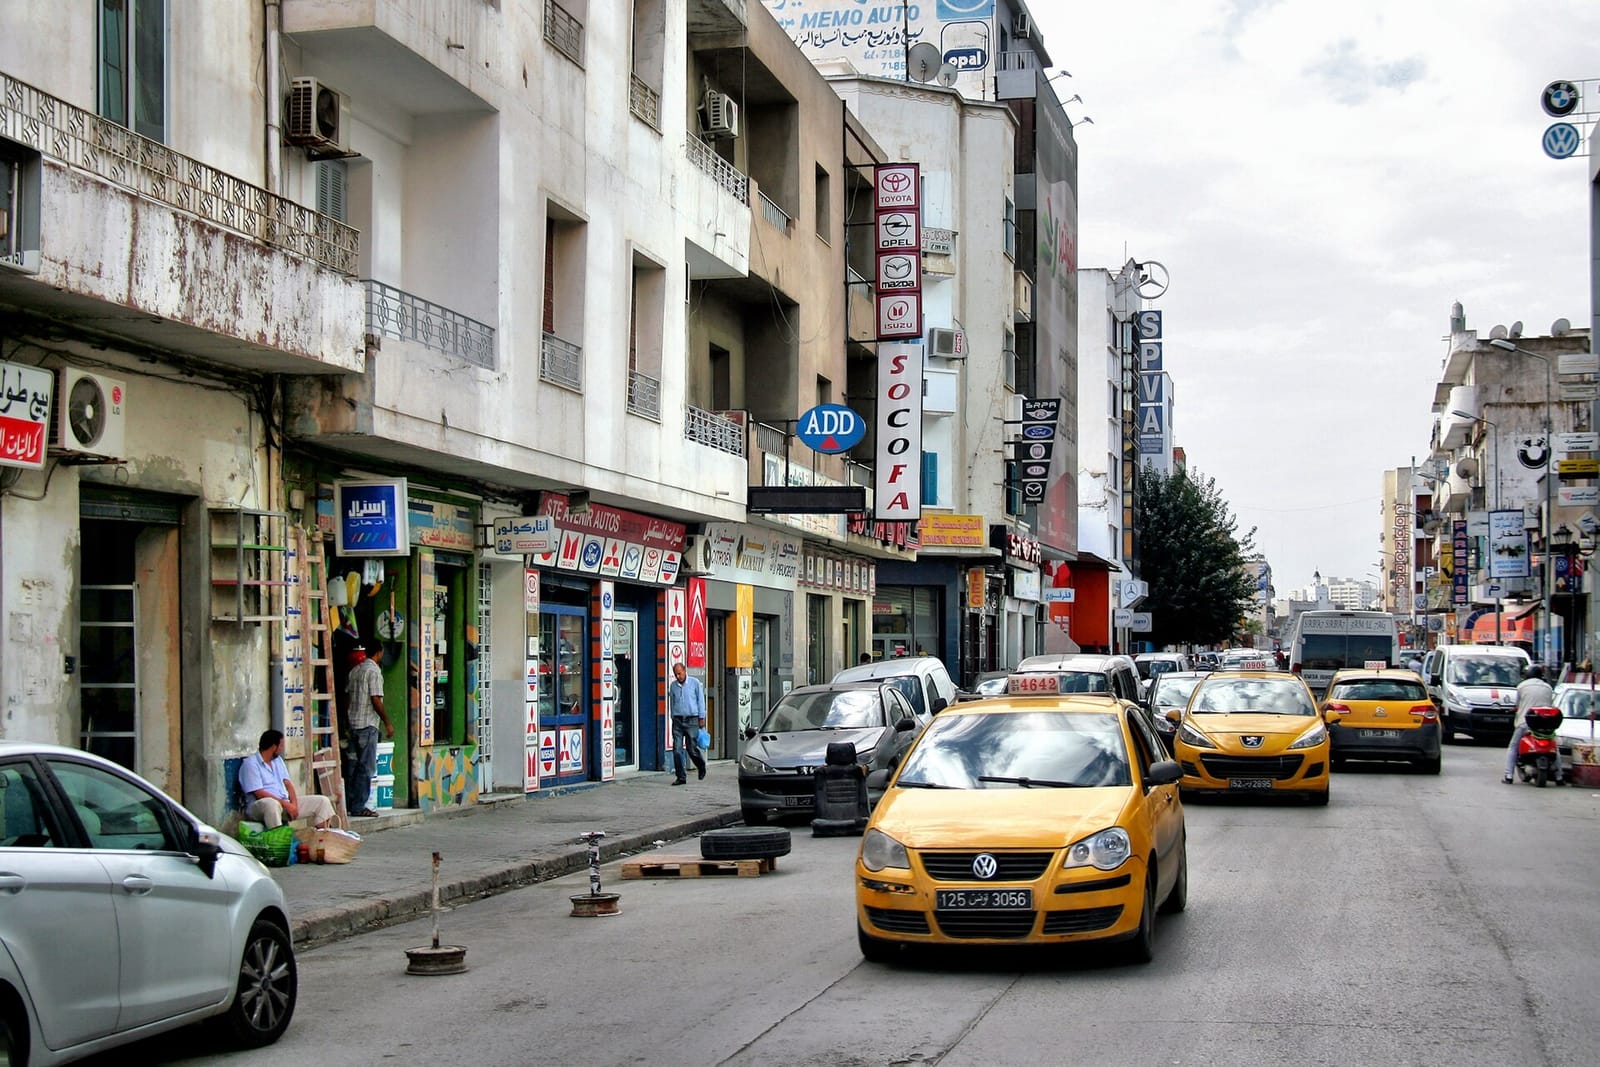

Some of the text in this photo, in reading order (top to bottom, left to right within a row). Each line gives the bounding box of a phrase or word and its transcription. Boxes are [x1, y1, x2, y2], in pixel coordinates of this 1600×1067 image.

[800, 9, 864, 29] MEMO
[866, 4, 920, 24] AUTO
[881, 195, 913, 203] TOYOTA
[882, 239, 913, 247] OPEL
[1140, 311, 1161, 434] SPVA
[804, 410, 855, 435] ADD
[886, 354, 911, 511] SOCOFA
[545, 499, 621, 533] STE AVENIR AUTOS
[1454, 521, 1467, 603] PAREBRISE
[424, 623, 432, 740] INTERCOLOR
[1020, 677, 1057, 692] 4642
[941, 893, 966, 907] 125
[992, 892, 1026, 907] 3056
